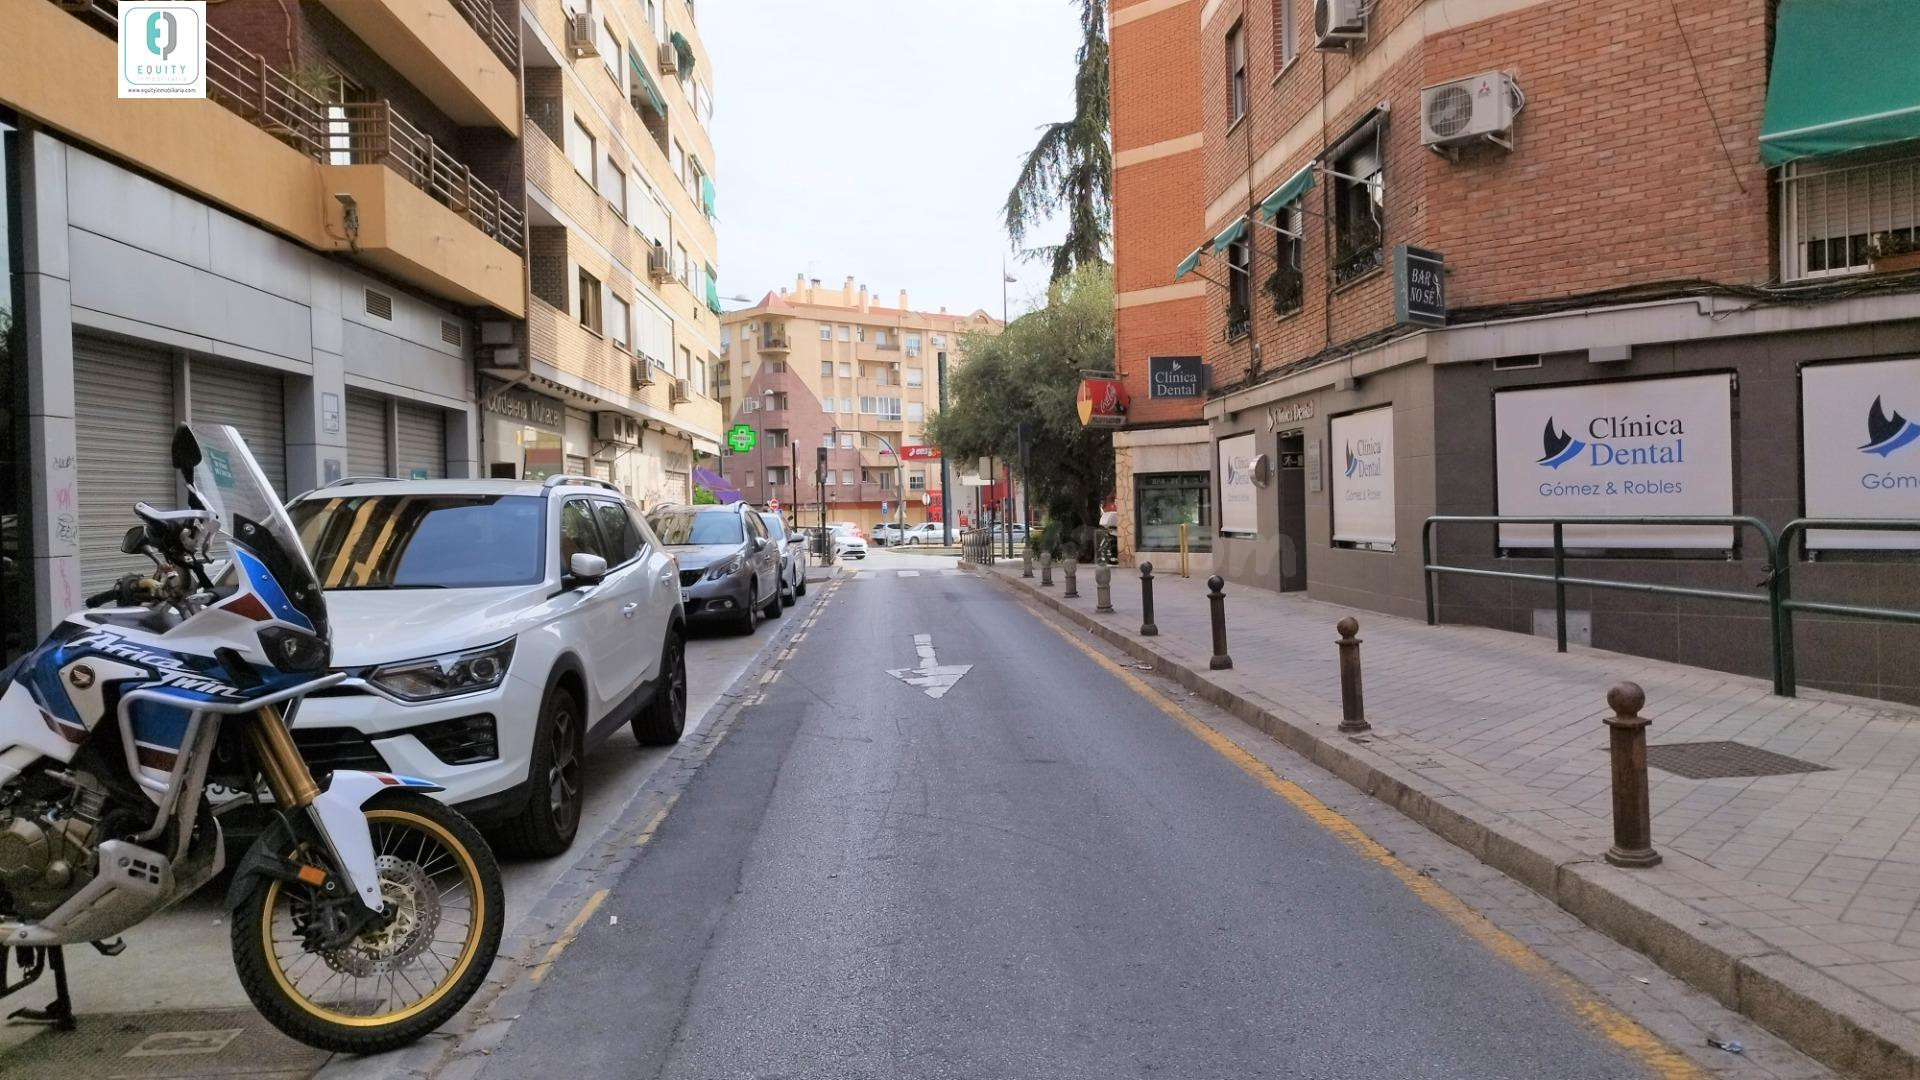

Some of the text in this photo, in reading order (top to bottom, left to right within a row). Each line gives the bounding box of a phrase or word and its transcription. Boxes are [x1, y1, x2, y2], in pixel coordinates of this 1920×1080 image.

[1412, 268, 1432, 286] BAR
[1410, 286, 1435, 305] NO SÉ
[1157, 384, 1196, 396] Dental
[1589, 415, 1684, 439] Clínica
[1590, 439, 1684, 466] Dental
[1358, 457, 1382, 478] Dental
[1539, 480, 1682, 497] Gómez & Robles
[1861, 472, 1920, 490] Góm
[64, 630, 184, 670] Africa
[137, 666, 251, 699] Twin
